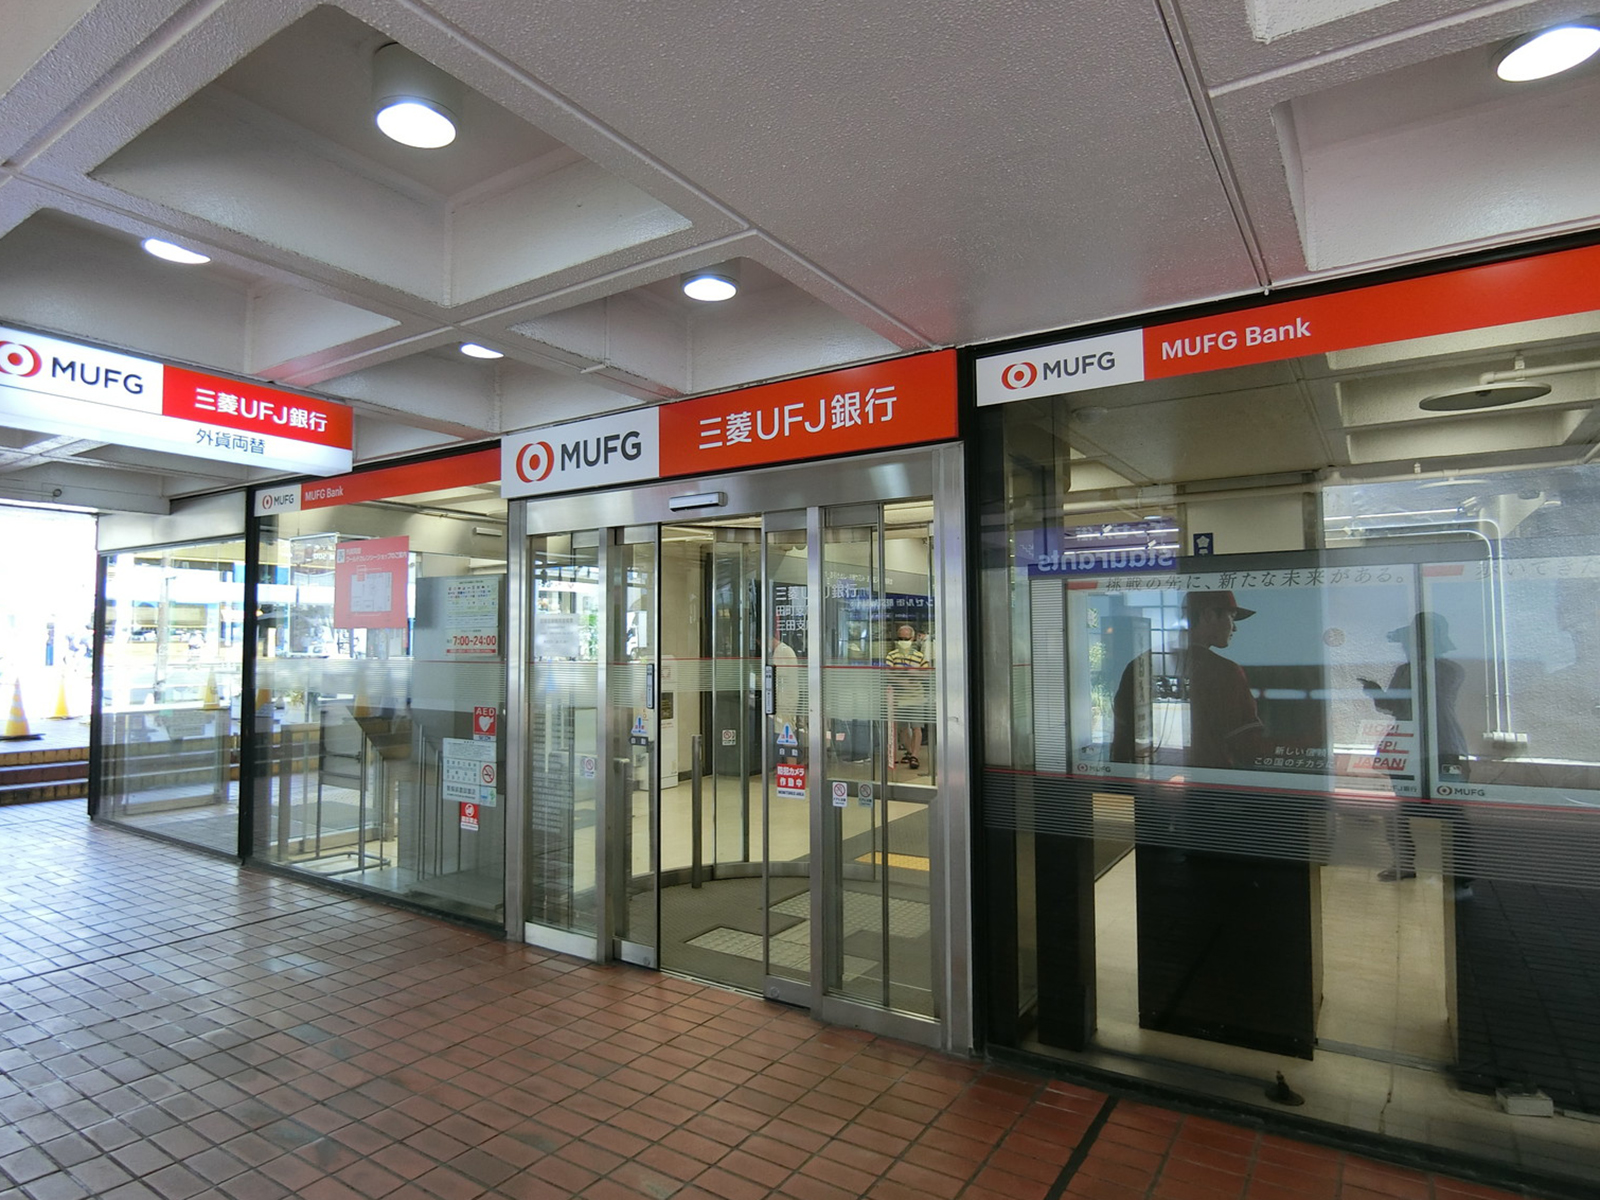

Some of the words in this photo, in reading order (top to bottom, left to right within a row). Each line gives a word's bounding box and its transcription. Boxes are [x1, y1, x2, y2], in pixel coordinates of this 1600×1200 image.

[1161, 330, 1239, 360] MUFG
[1245, 317, 1312, 347] Bank
[51, 356, 144, 395] MUFG
[1043, 351, 1116, 381] MUFG
[195, 387, 328, 433] 三菱UFJ銀行
[698, 385, 898, 450] 三菱UFJ銀行
[195, 428, 266, 456] 外貨両替
[560, 430, 642, 472] MUFG
[273, 494, 295, 507] MUFG
[304, 489, 326, 502] MUFG
[326, 486, 344, 498] Bank
[475, 707, 496, 716] AED
[1356, 757, 1407, 769] JAPAN!
[1454, 788, 1485, 797] MUFG
